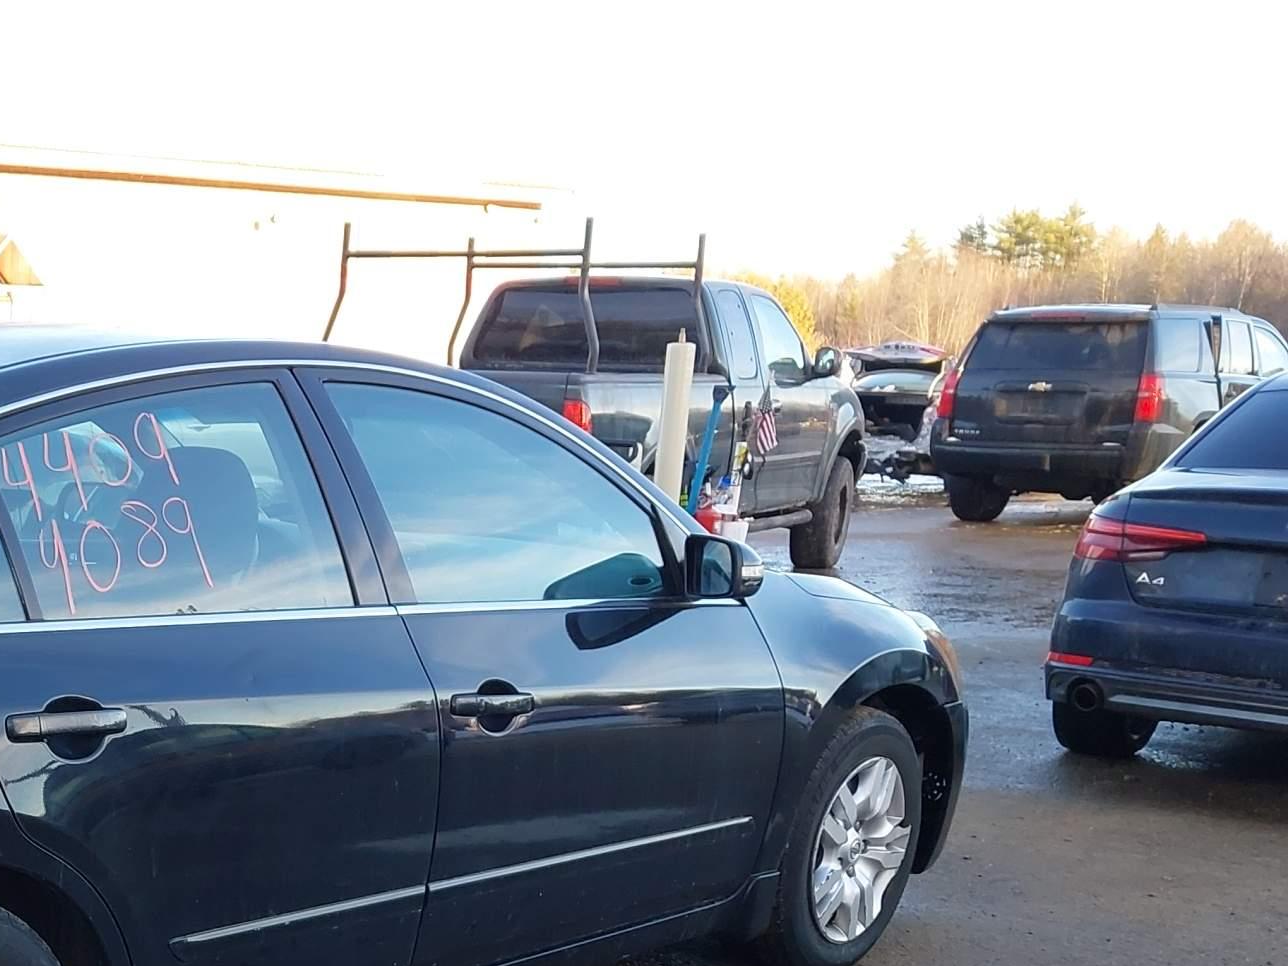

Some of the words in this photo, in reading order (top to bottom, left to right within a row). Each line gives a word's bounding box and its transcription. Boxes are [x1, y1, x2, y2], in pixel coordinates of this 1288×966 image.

[0, 411, 181, 523] 4409
[38, 496, 216, 616] 4089
[1135, 570, 1166, 587] A4
